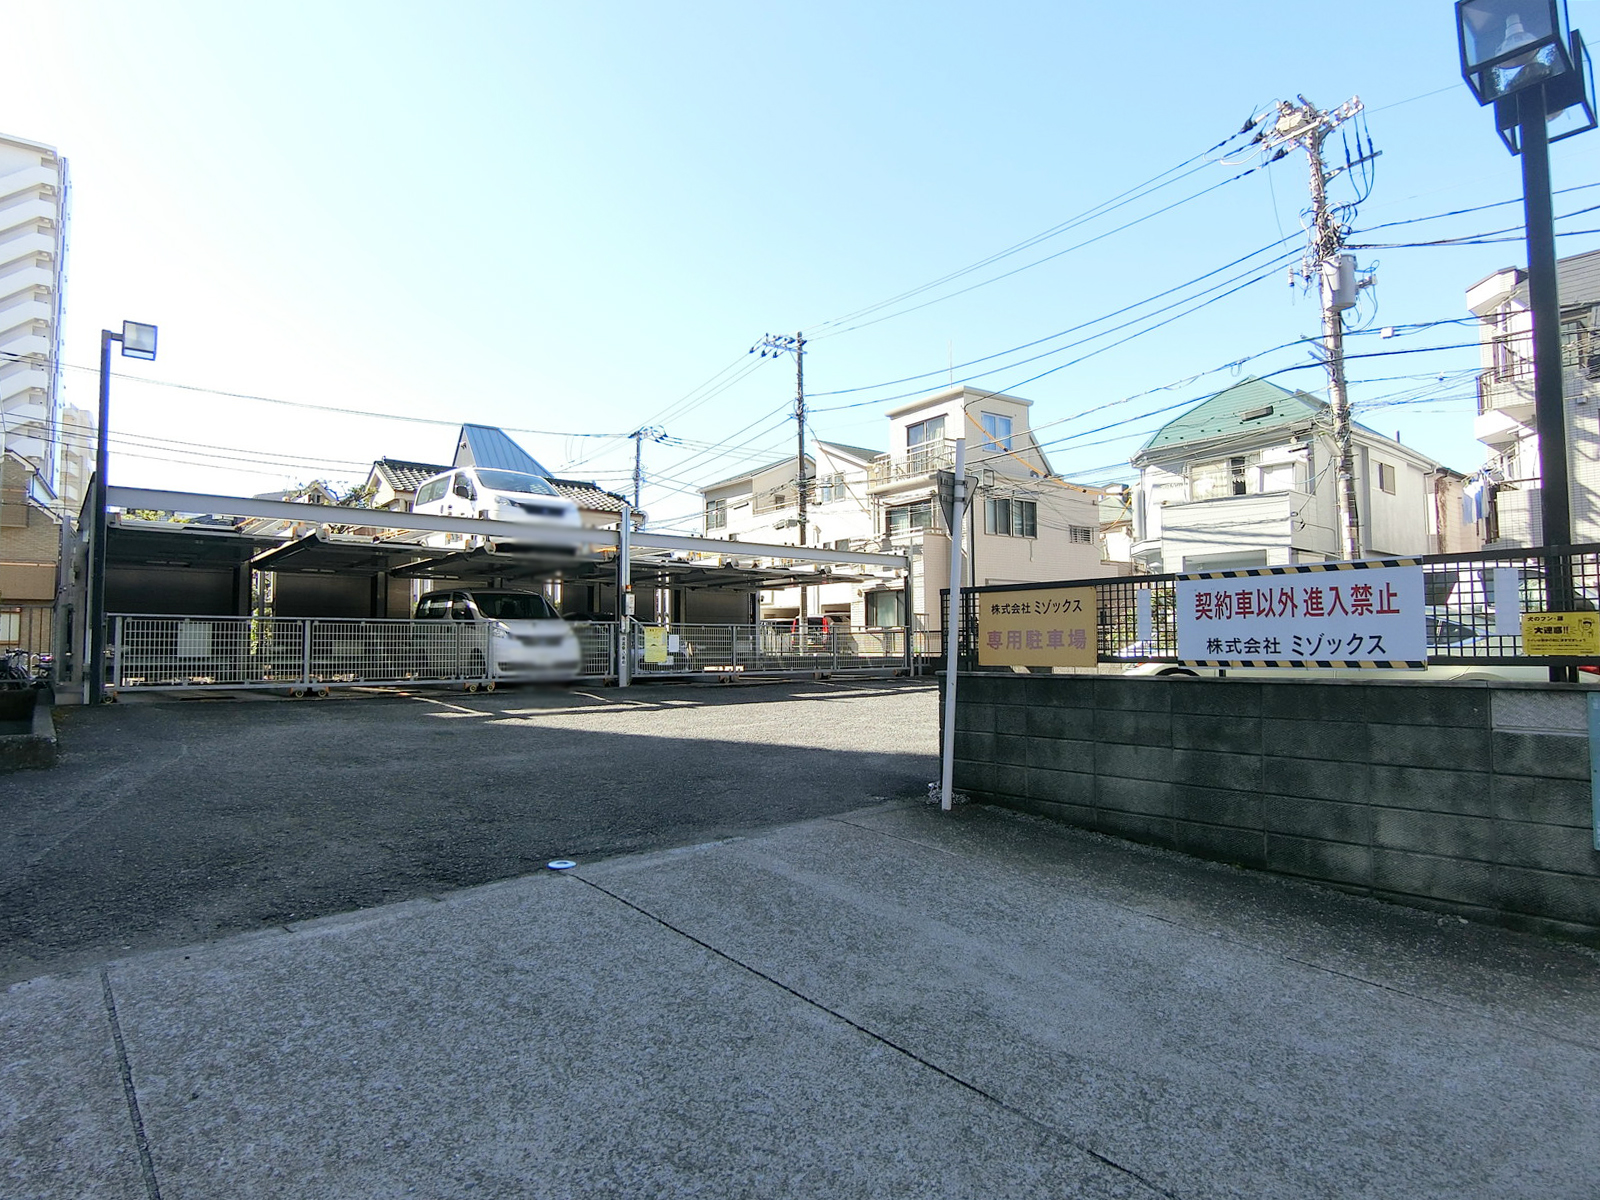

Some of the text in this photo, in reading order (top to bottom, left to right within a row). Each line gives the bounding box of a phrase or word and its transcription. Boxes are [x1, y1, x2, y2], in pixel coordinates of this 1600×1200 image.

[990, 599, 1083, 616] 株式会社 ミゾックス
[1195, 582, 1400, 620] 契約車以外進入禁止
[986, 629, 1087, 651] 専用駐車場
[1206, 633, 1387, 657] 株式会社 ミゾックス
